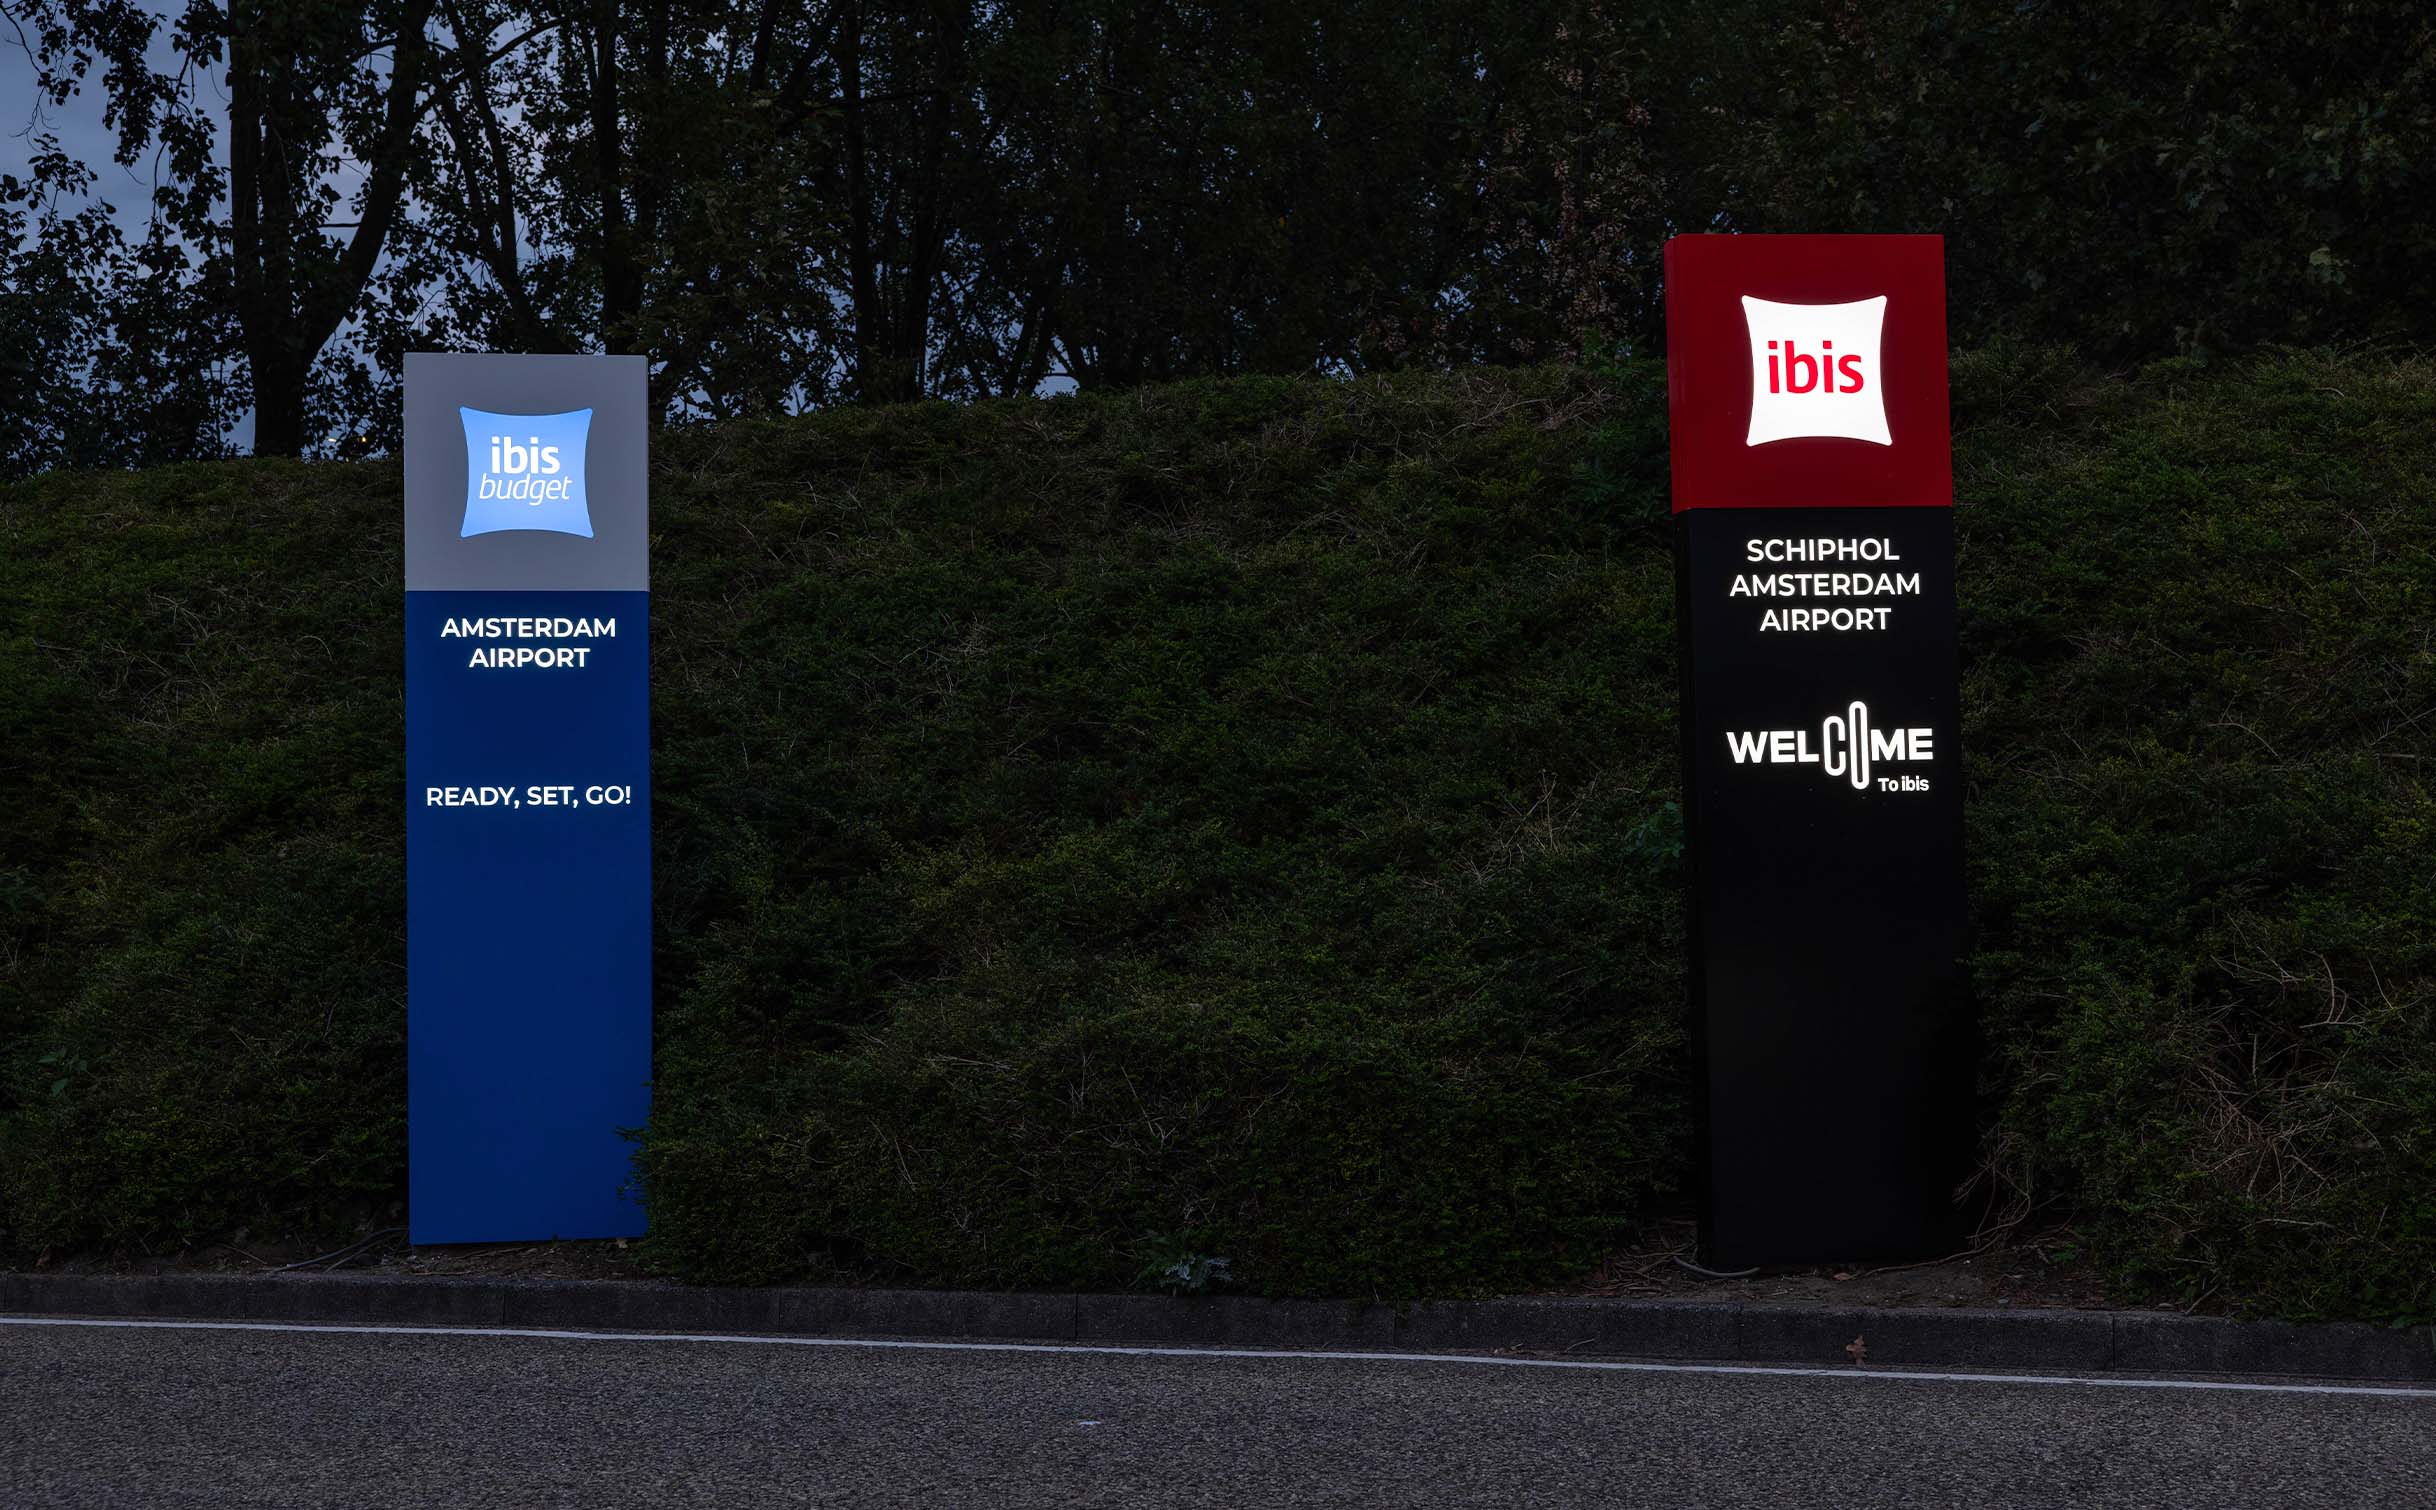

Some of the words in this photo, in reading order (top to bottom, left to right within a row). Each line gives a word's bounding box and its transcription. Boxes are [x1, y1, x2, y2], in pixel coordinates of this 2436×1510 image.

[1767, 340, 1865, 394] ibis
[491, 436, 561, 474] ibis
[479, 472, 573, 506] budget
[1747, 538, 1900, 562] SCHIPHOL
[1729, 572, 1921, 597] AMSTERDAM
[440, 617, 617, 638] AMSTERDAM
[1759, 607, 1892, 632] AIRPORT
[468, 647, 591, 668] AIRPORT
[1726, 700, 1934, 790] WELCOME
[1877, 777, 1899, 792] To
[1901, 775, 1930, 792] ibis
[426, 786, 520, 809] READY,
[526, 785, 579, 809] SET,
[585, 785, 632, 805] GO!
